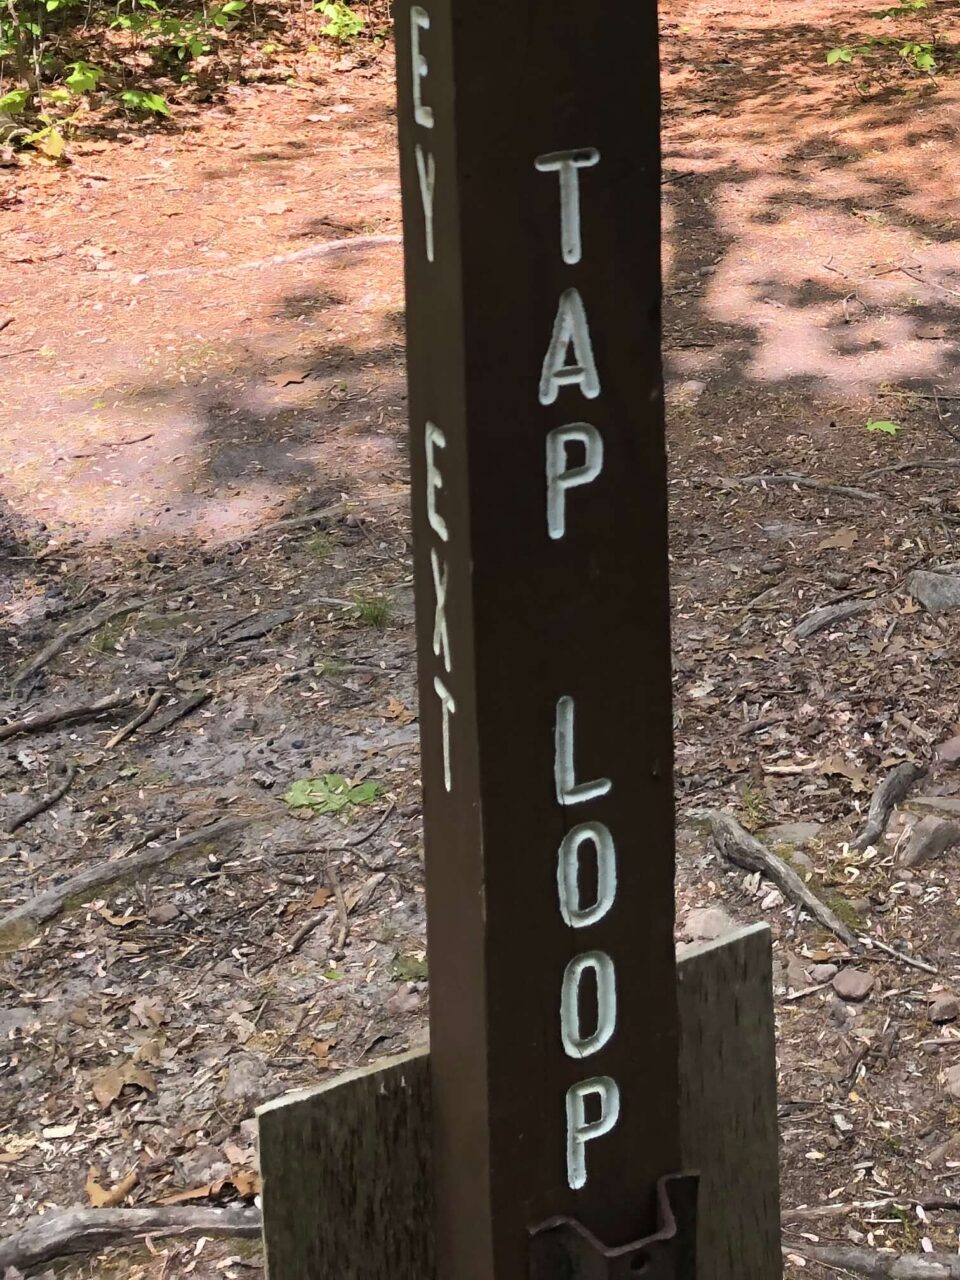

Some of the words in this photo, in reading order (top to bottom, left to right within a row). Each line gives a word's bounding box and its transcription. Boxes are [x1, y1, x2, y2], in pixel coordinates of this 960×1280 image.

[534, 147, 604, 540] TAP
[424, 420, 456, 793] EXT
[553, 694, 621, 1191] LOOP
